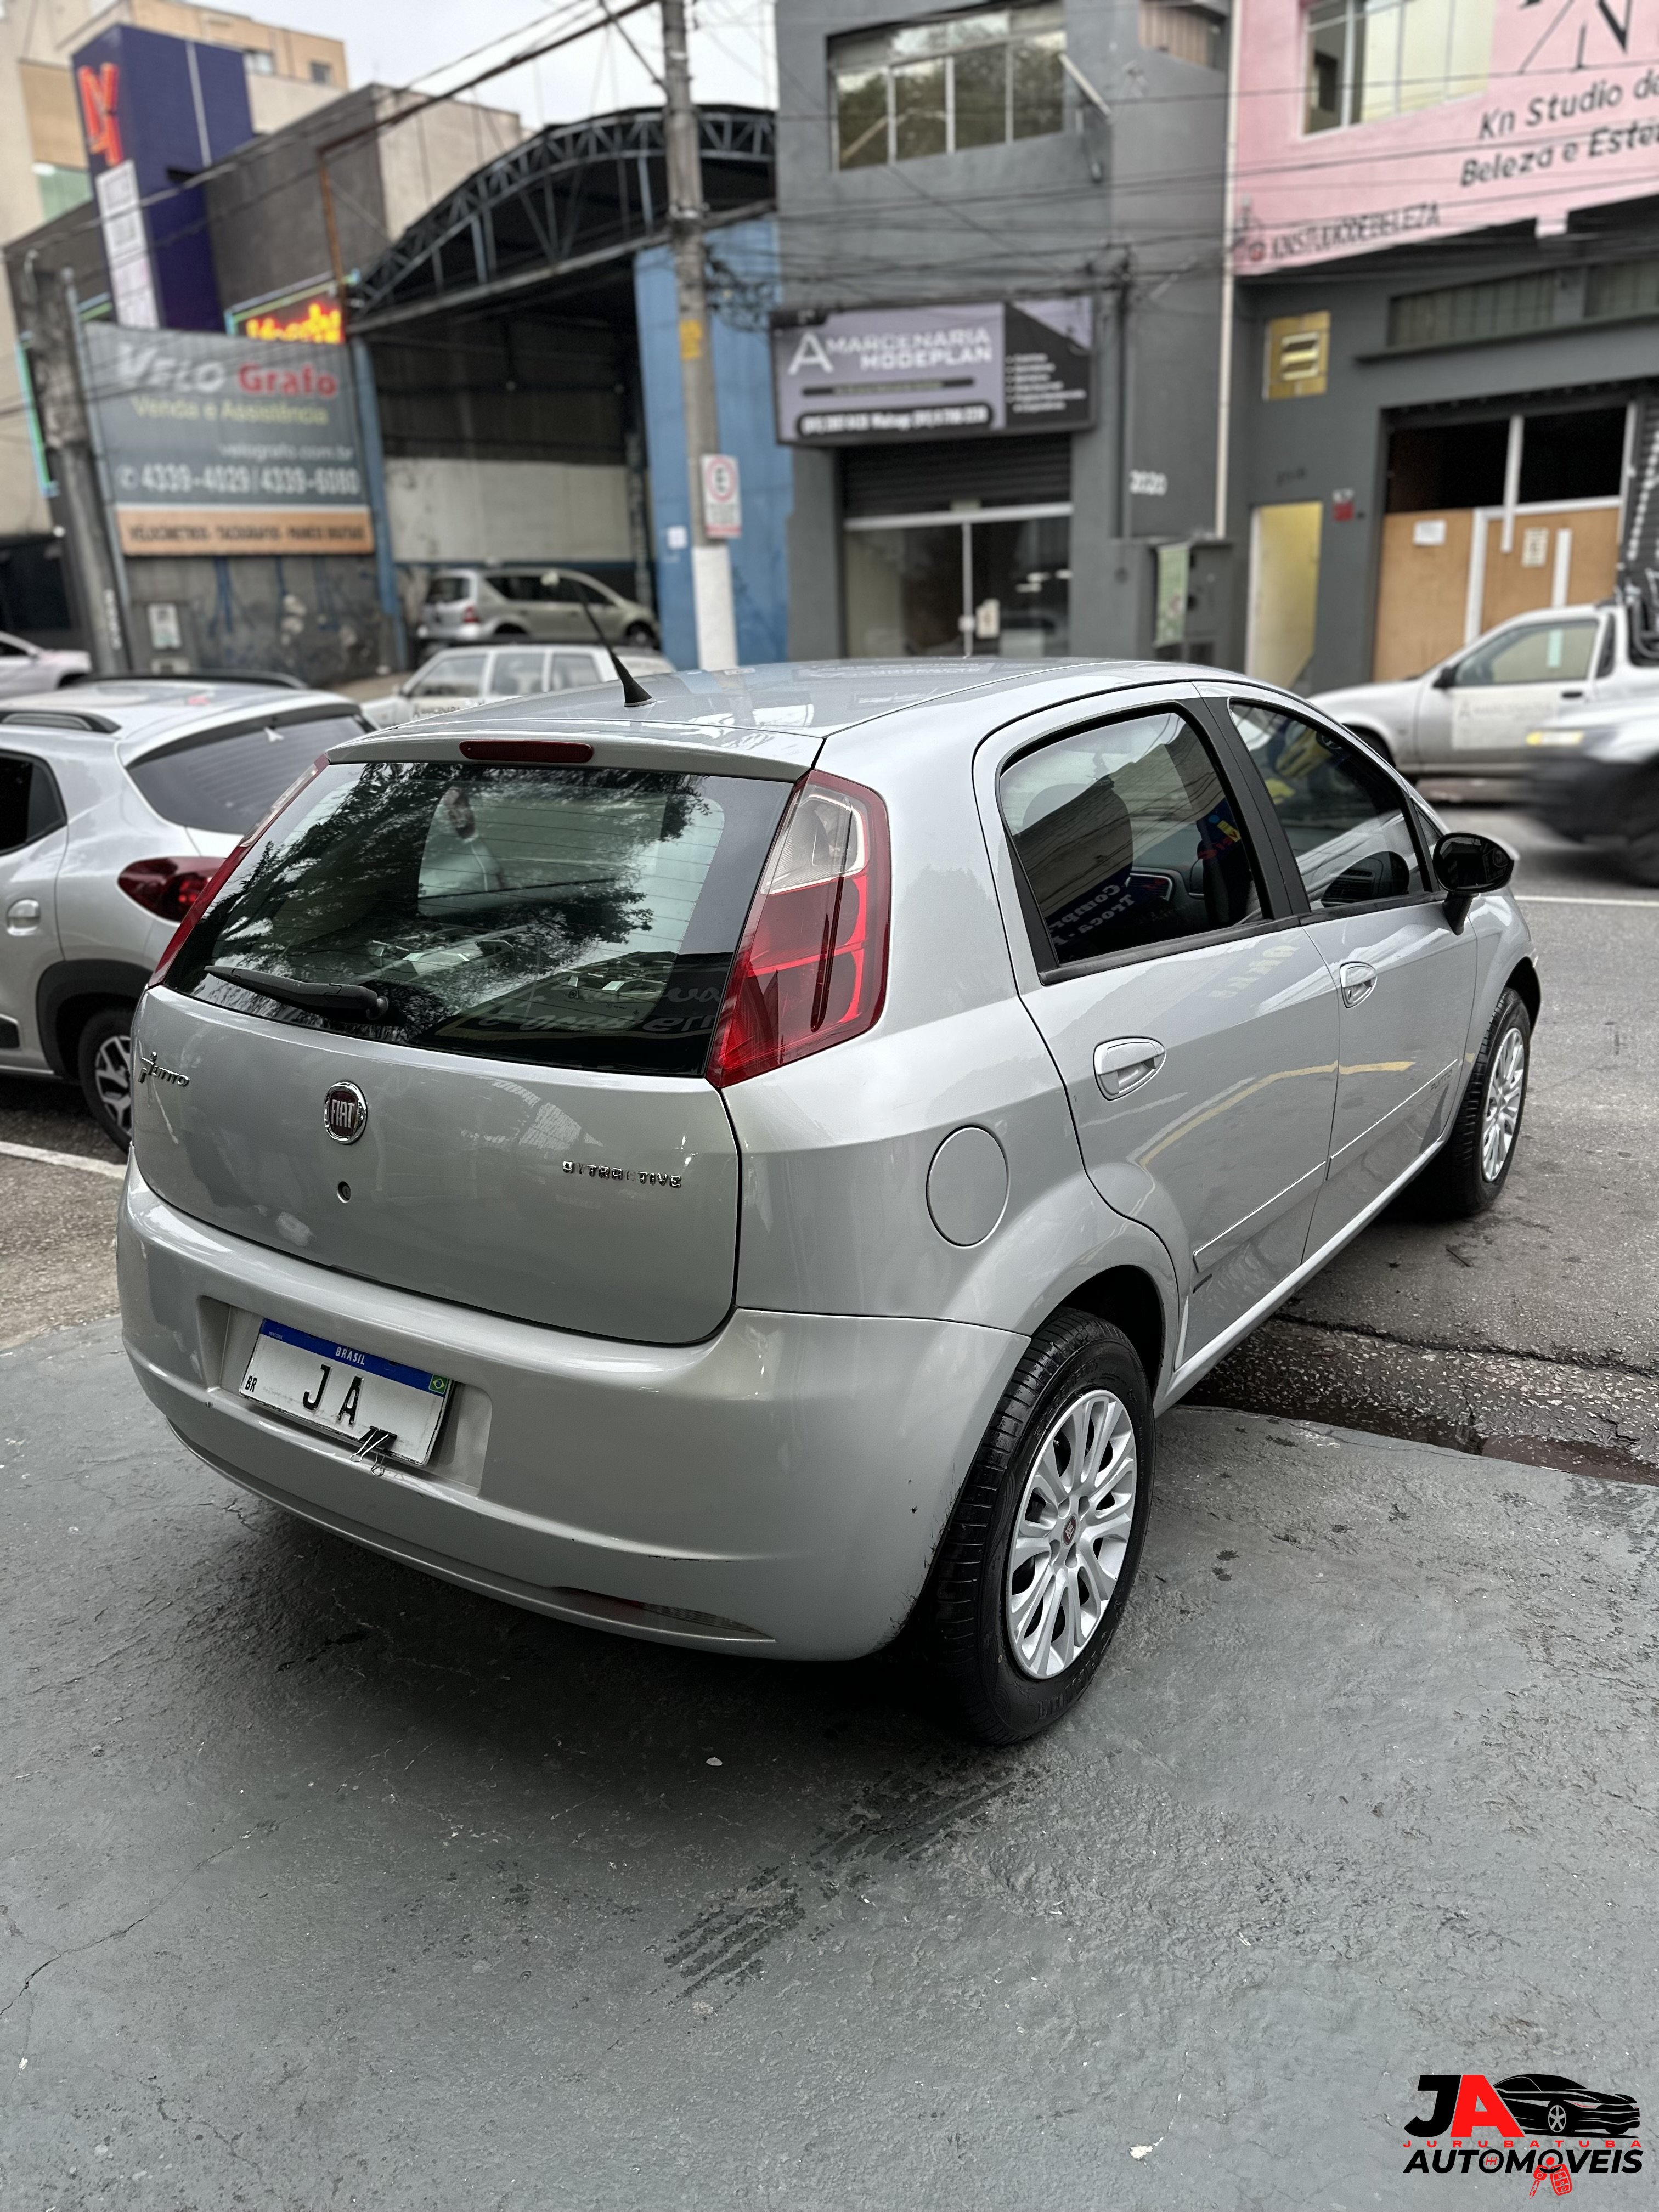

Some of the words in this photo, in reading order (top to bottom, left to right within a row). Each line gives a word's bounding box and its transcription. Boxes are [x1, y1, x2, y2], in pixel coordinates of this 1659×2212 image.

[1480, 108, 1515, 139] Kn
[1526, 79, 1622, 127] Studio
[1460, 145, 1554, 187] Beleza
[1562, 142, 1578, 162] e
[1588, 120, 1658, 158] Este
[238, 361, 338, 398] Grafo
[131, 395, 199, 421] Venda
[331, 1099, 356, 1129] FIAT
[335, 1346, 366, 1365] BRASIL
[245, 1375, 258, 1393] BR
